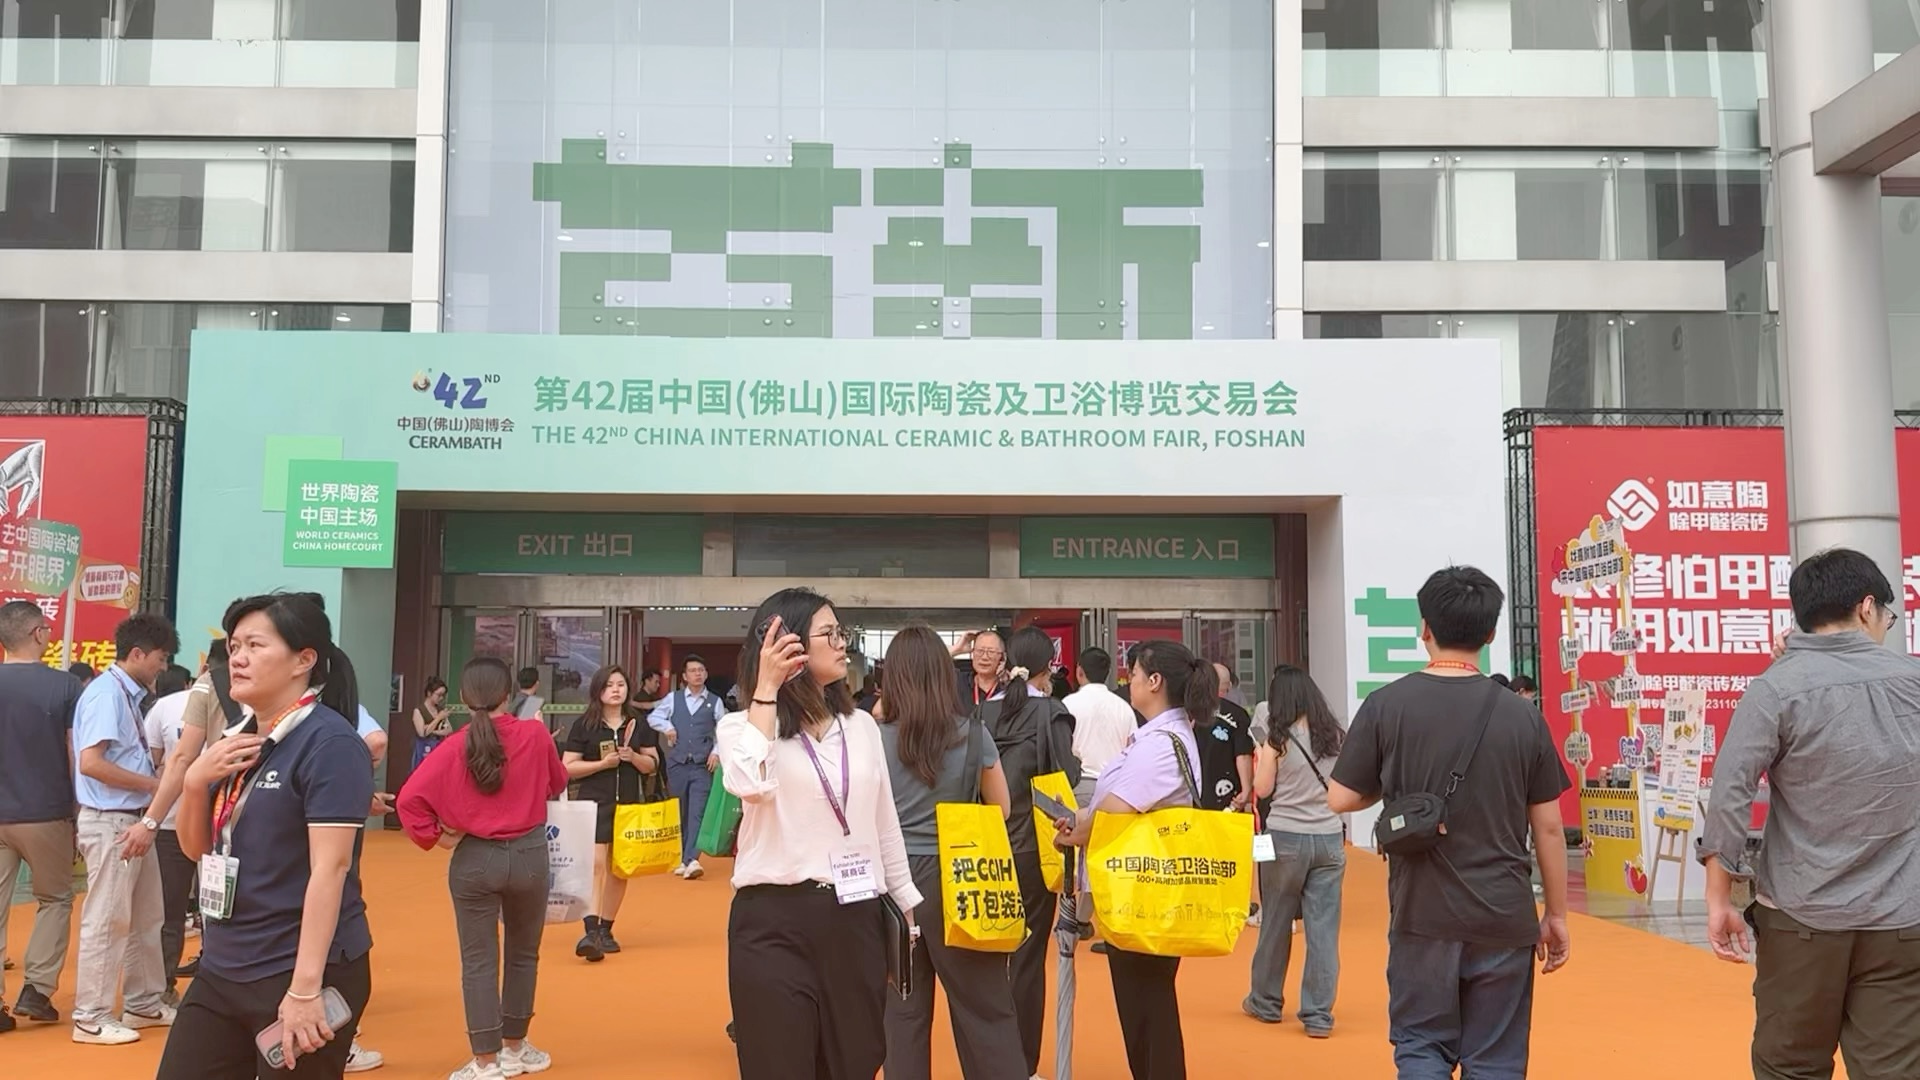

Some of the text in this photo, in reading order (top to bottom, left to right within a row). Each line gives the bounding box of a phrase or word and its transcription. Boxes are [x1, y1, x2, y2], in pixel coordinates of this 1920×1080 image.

[534, 375, 1298, 418] 第42届中国(佛山)国际陶瓷及卫浴博览交易会
[397, 416, 515, 433] 中国(佛山)陶博会
[409, 434, 502, 450] CERAMBATH
[532, 426, 1305, 451] THE 42ND CHINA INTERNATIONAL CERAMIC & BATHROOM FAIR, FOSHAN
[301, 483, 379, 503] 世界陶瓷
[1667, 480, 1768, 509] 如意陶
[300, 506, 378, 527] 中国主场
[1669, 512, 1768, 532] 除甲醛瓷砖
[2, 522, 80, 555] 去中国陶瓷城
[296, 531, 379, 540] WORLD CERAMICS
[518, 533, 633, 557] EXIT 出口
[293, 542, 383, 551] CHINA HOMECOURT
[1052, 538, 1239, 561] ENTRANCE 入口
[1568, 554, 1791, 601] 修怕甲
[1641, 675, 1757, 692] 除甲醛瓷砖发
[625, 824, 682, 842] 中国陶瓷卫浴总
[1106, 856, 1237, 879] 中国陶瓷卫浴总部
